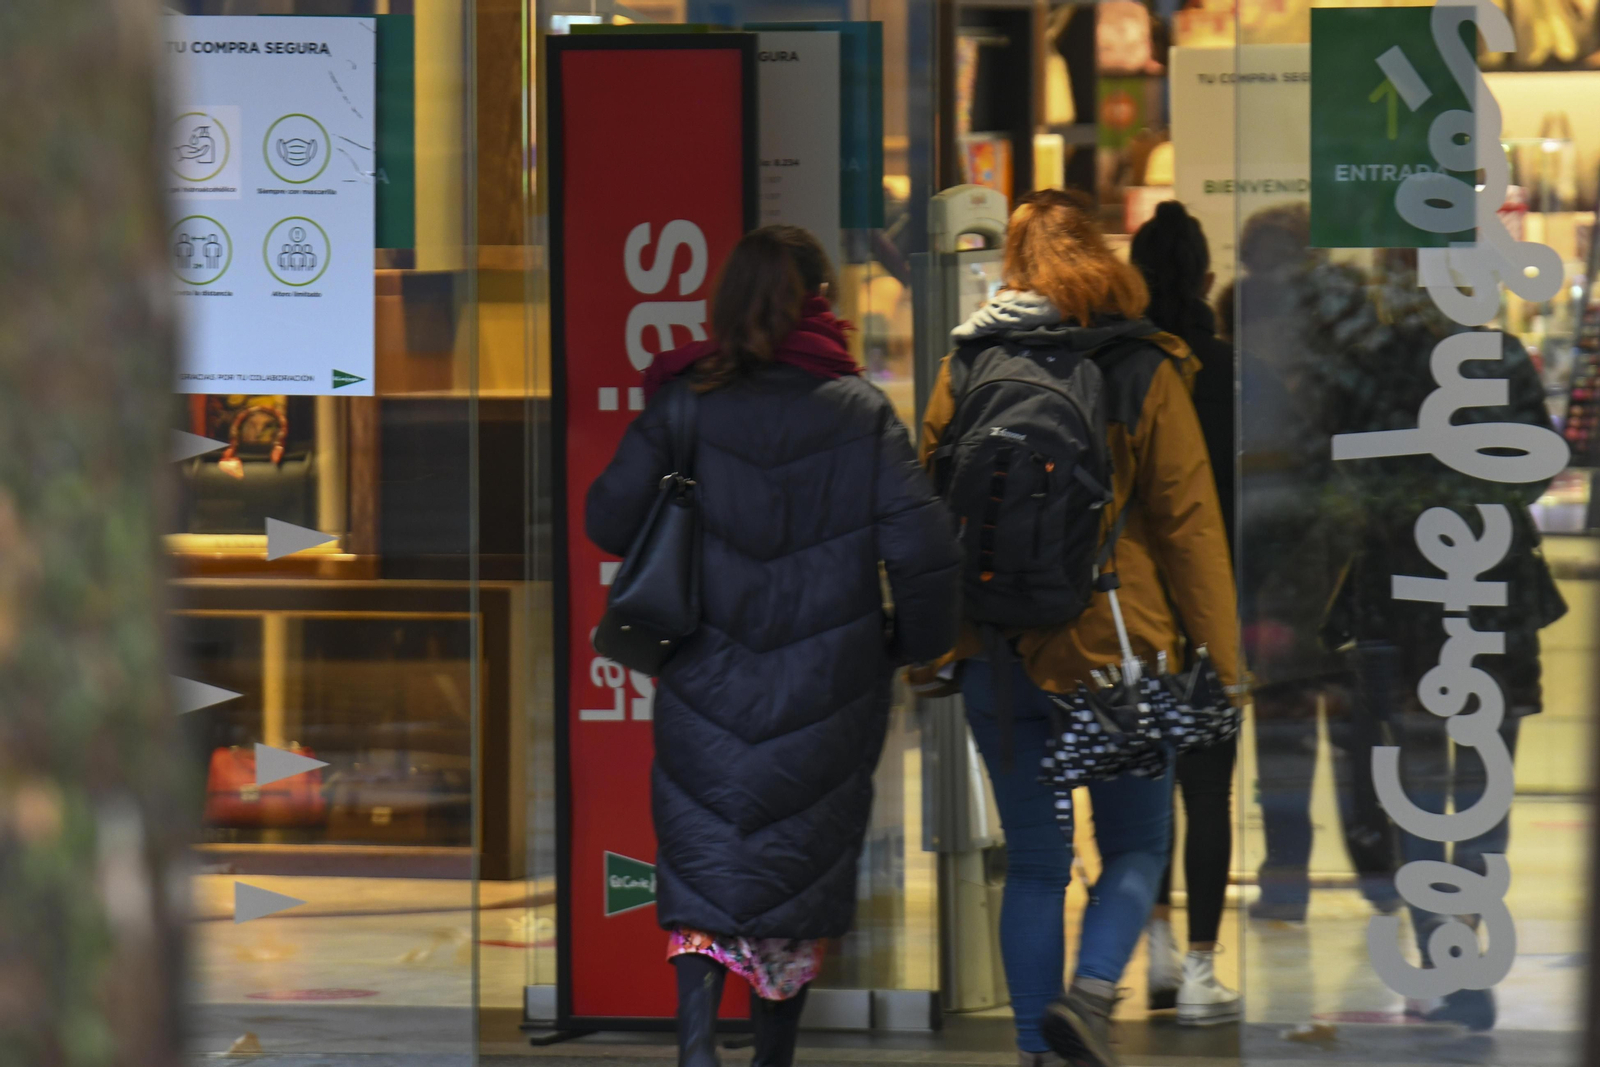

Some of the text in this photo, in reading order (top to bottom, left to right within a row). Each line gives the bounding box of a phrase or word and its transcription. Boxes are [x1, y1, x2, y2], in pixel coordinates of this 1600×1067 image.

[190, 42, 260, 54] COMPRA
[264, 42, 331, 54] SEGURA
[757, 51, 799, 62] GURA
[1197, 73, 1215, 84] TU
[1220, 72, 1278, 84] COMPRA
[1371, 504, 1513, 842] Corte
[1367, 853, 1517, 999] El
